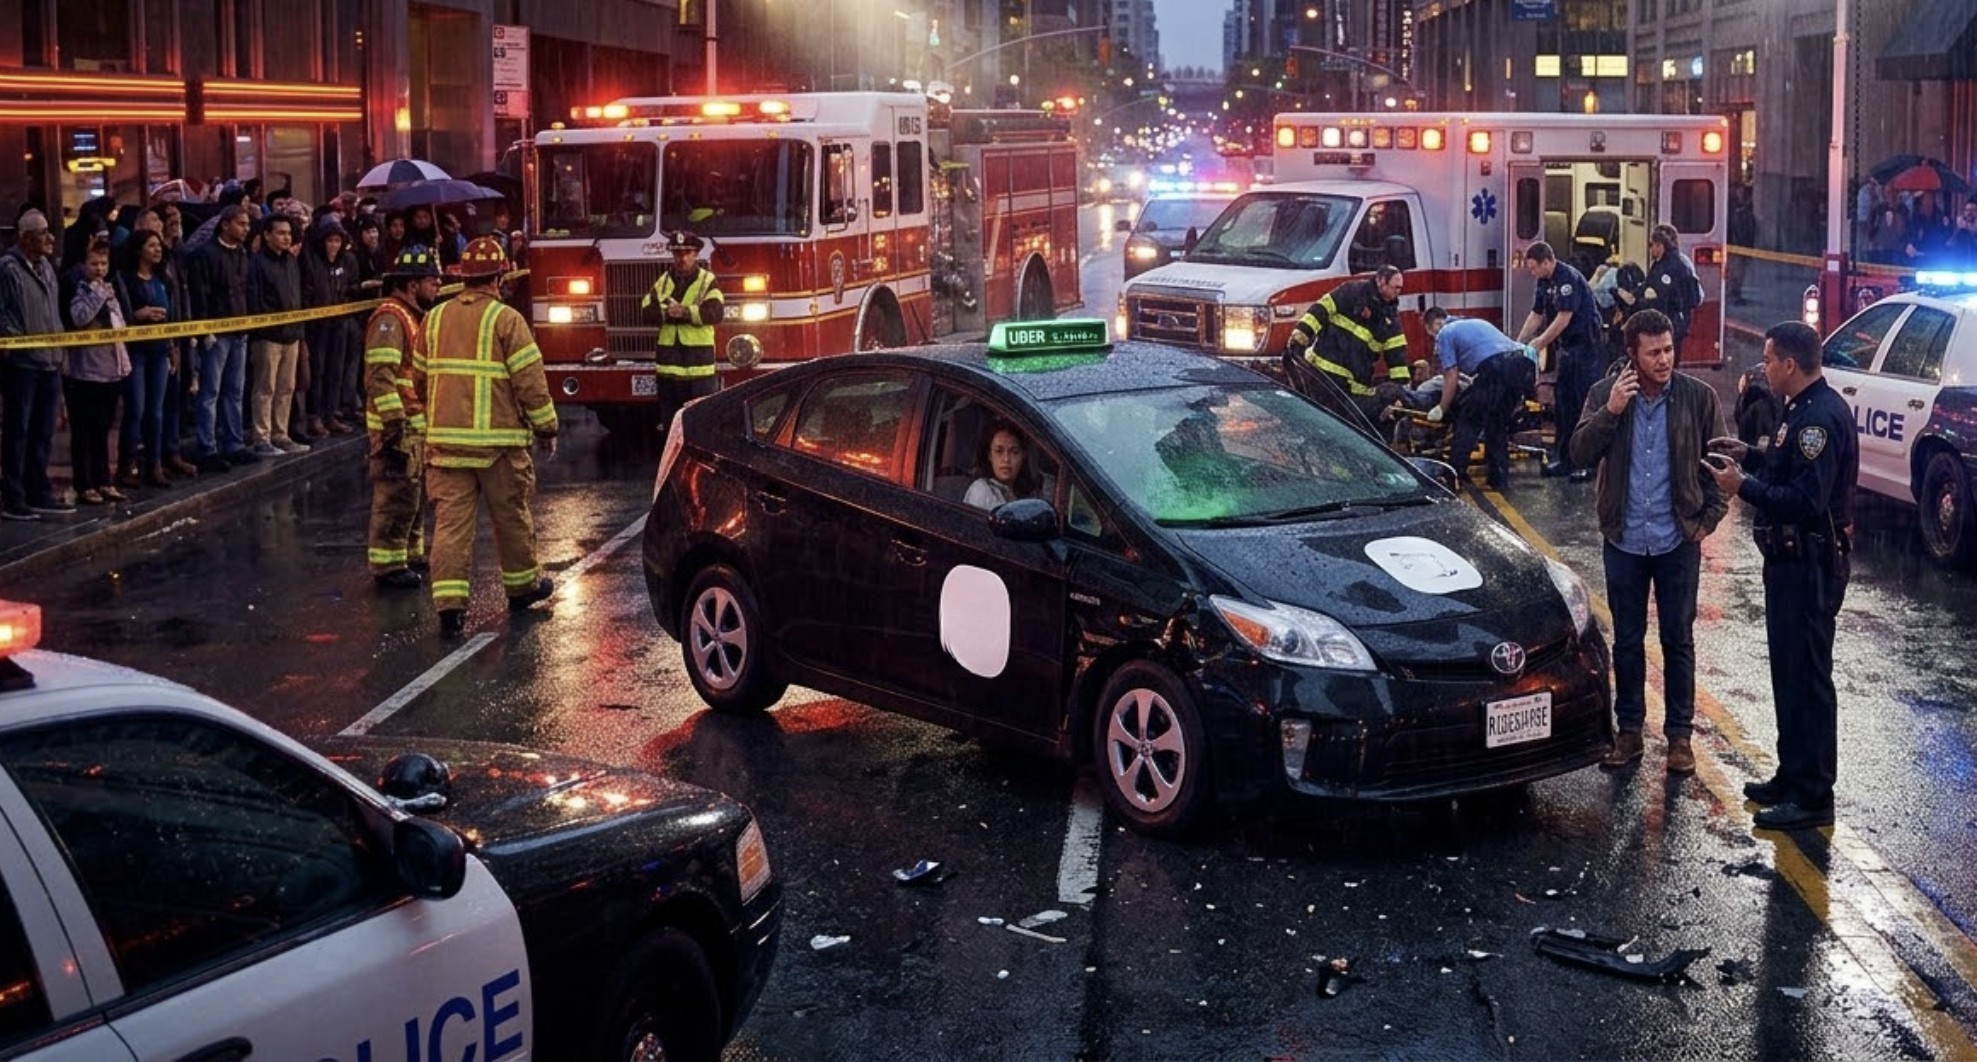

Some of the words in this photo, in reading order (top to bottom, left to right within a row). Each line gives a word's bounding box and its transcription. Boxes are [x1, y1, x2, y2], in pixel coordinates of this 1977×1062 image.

[1008, 330, 1046, 345] UBER
[1854, 405, 1904, 442] LICE
[316, 969, 523, 1062] ICE
